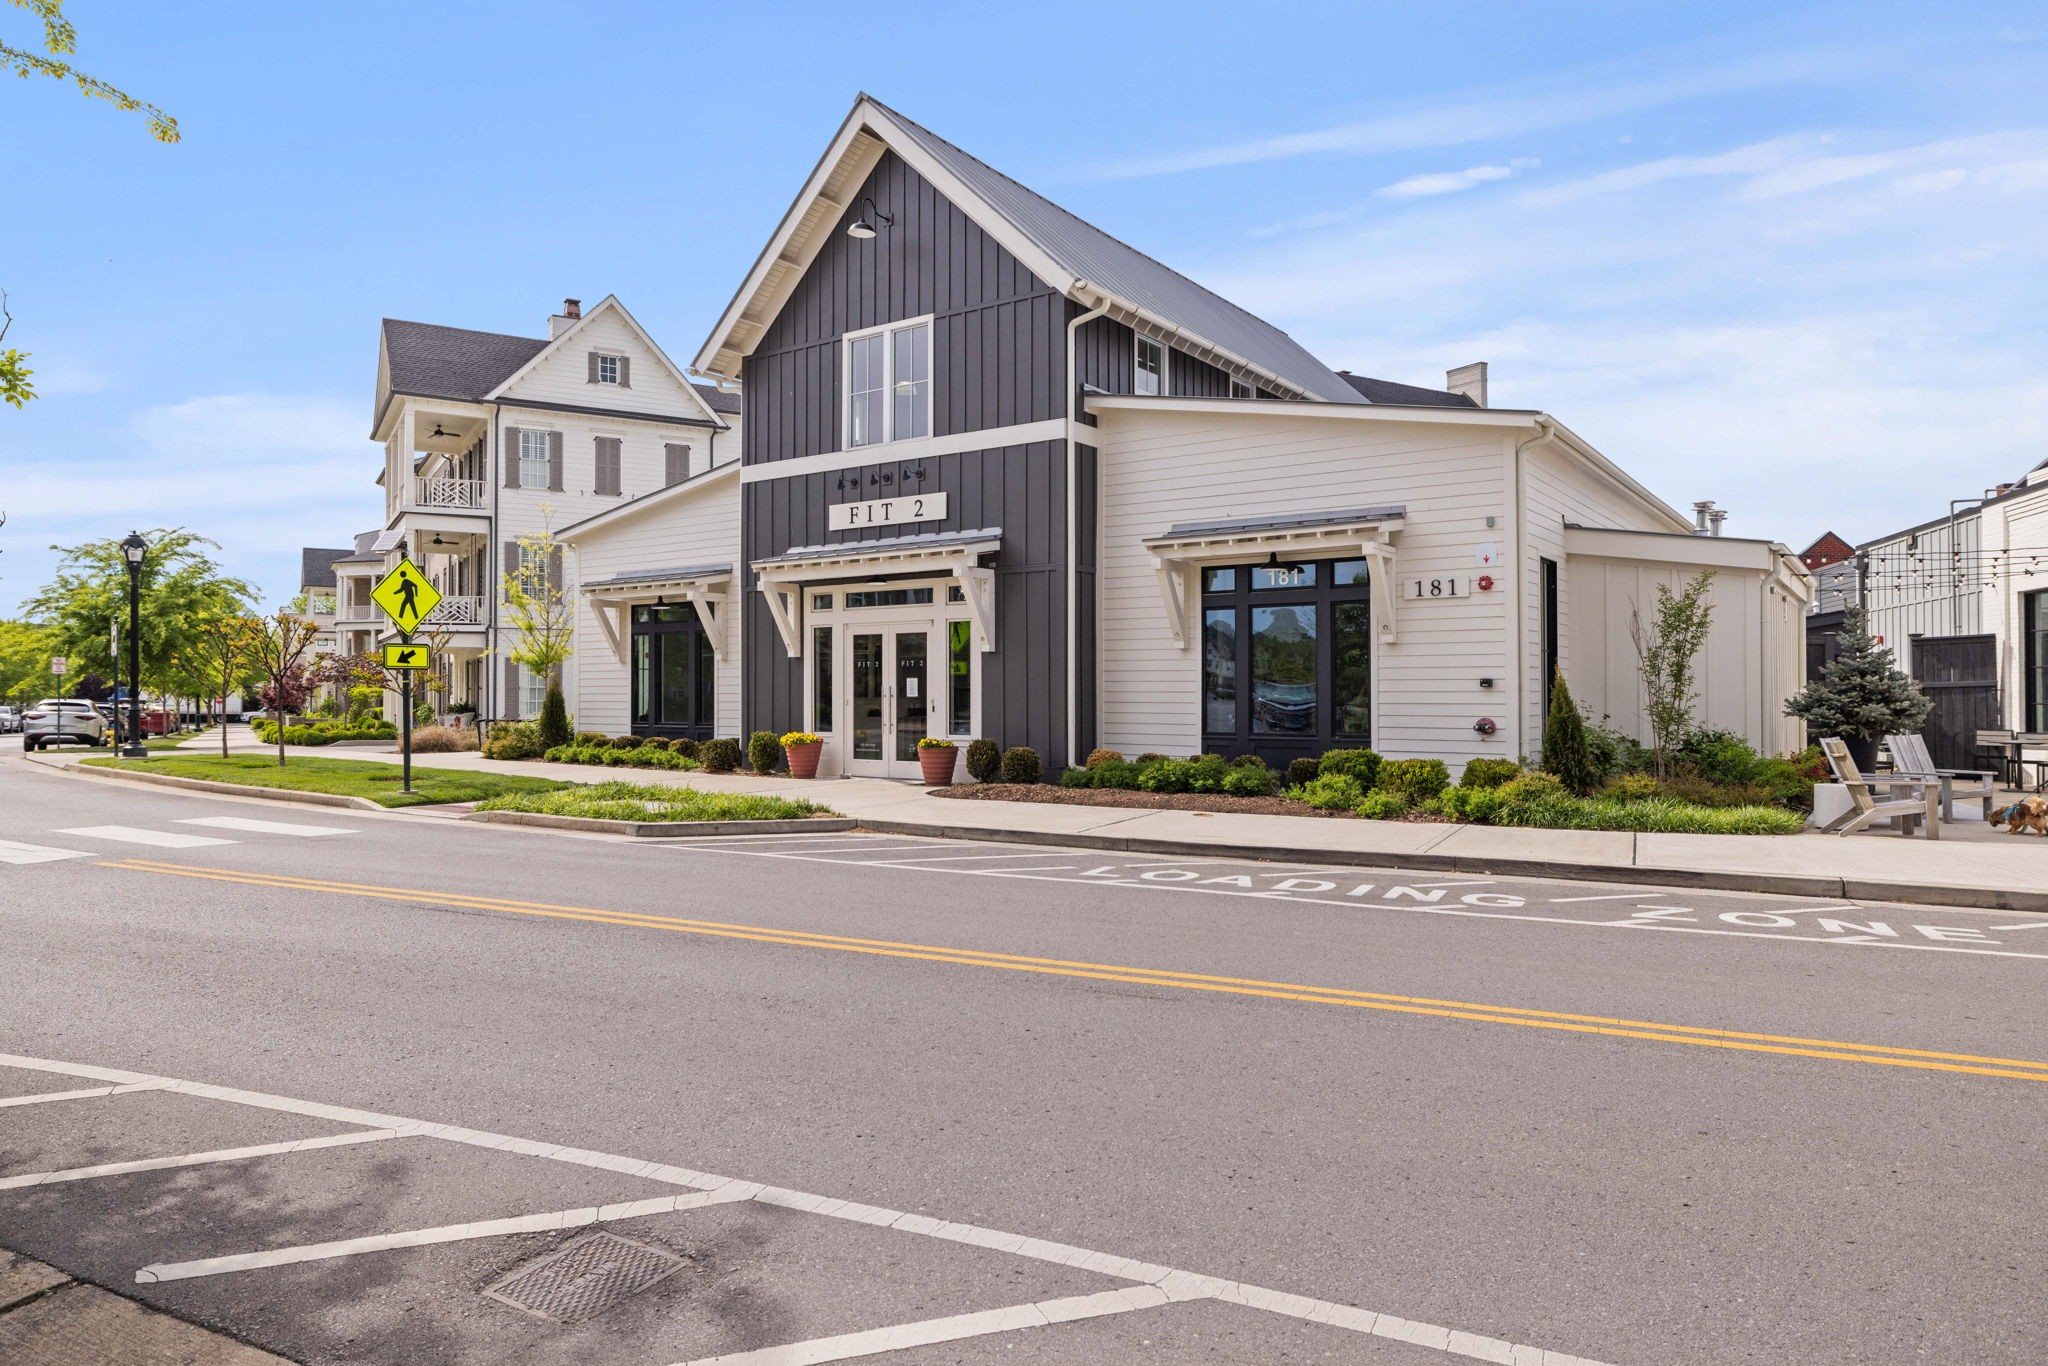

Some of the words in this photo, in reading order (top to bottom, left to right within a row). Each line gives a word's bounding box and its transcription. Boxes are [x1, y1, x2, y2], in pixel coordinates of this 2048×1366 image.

[849, 502, 893, 524] FIT
[914, 499, 924, 518] 2
[1267, 568, 1299, 586] 181
[1414, 578, 1458, 597] 181
[1078, 865, 1526, 908] LOADING
[1631, 904, 2003, 944] ZONE
